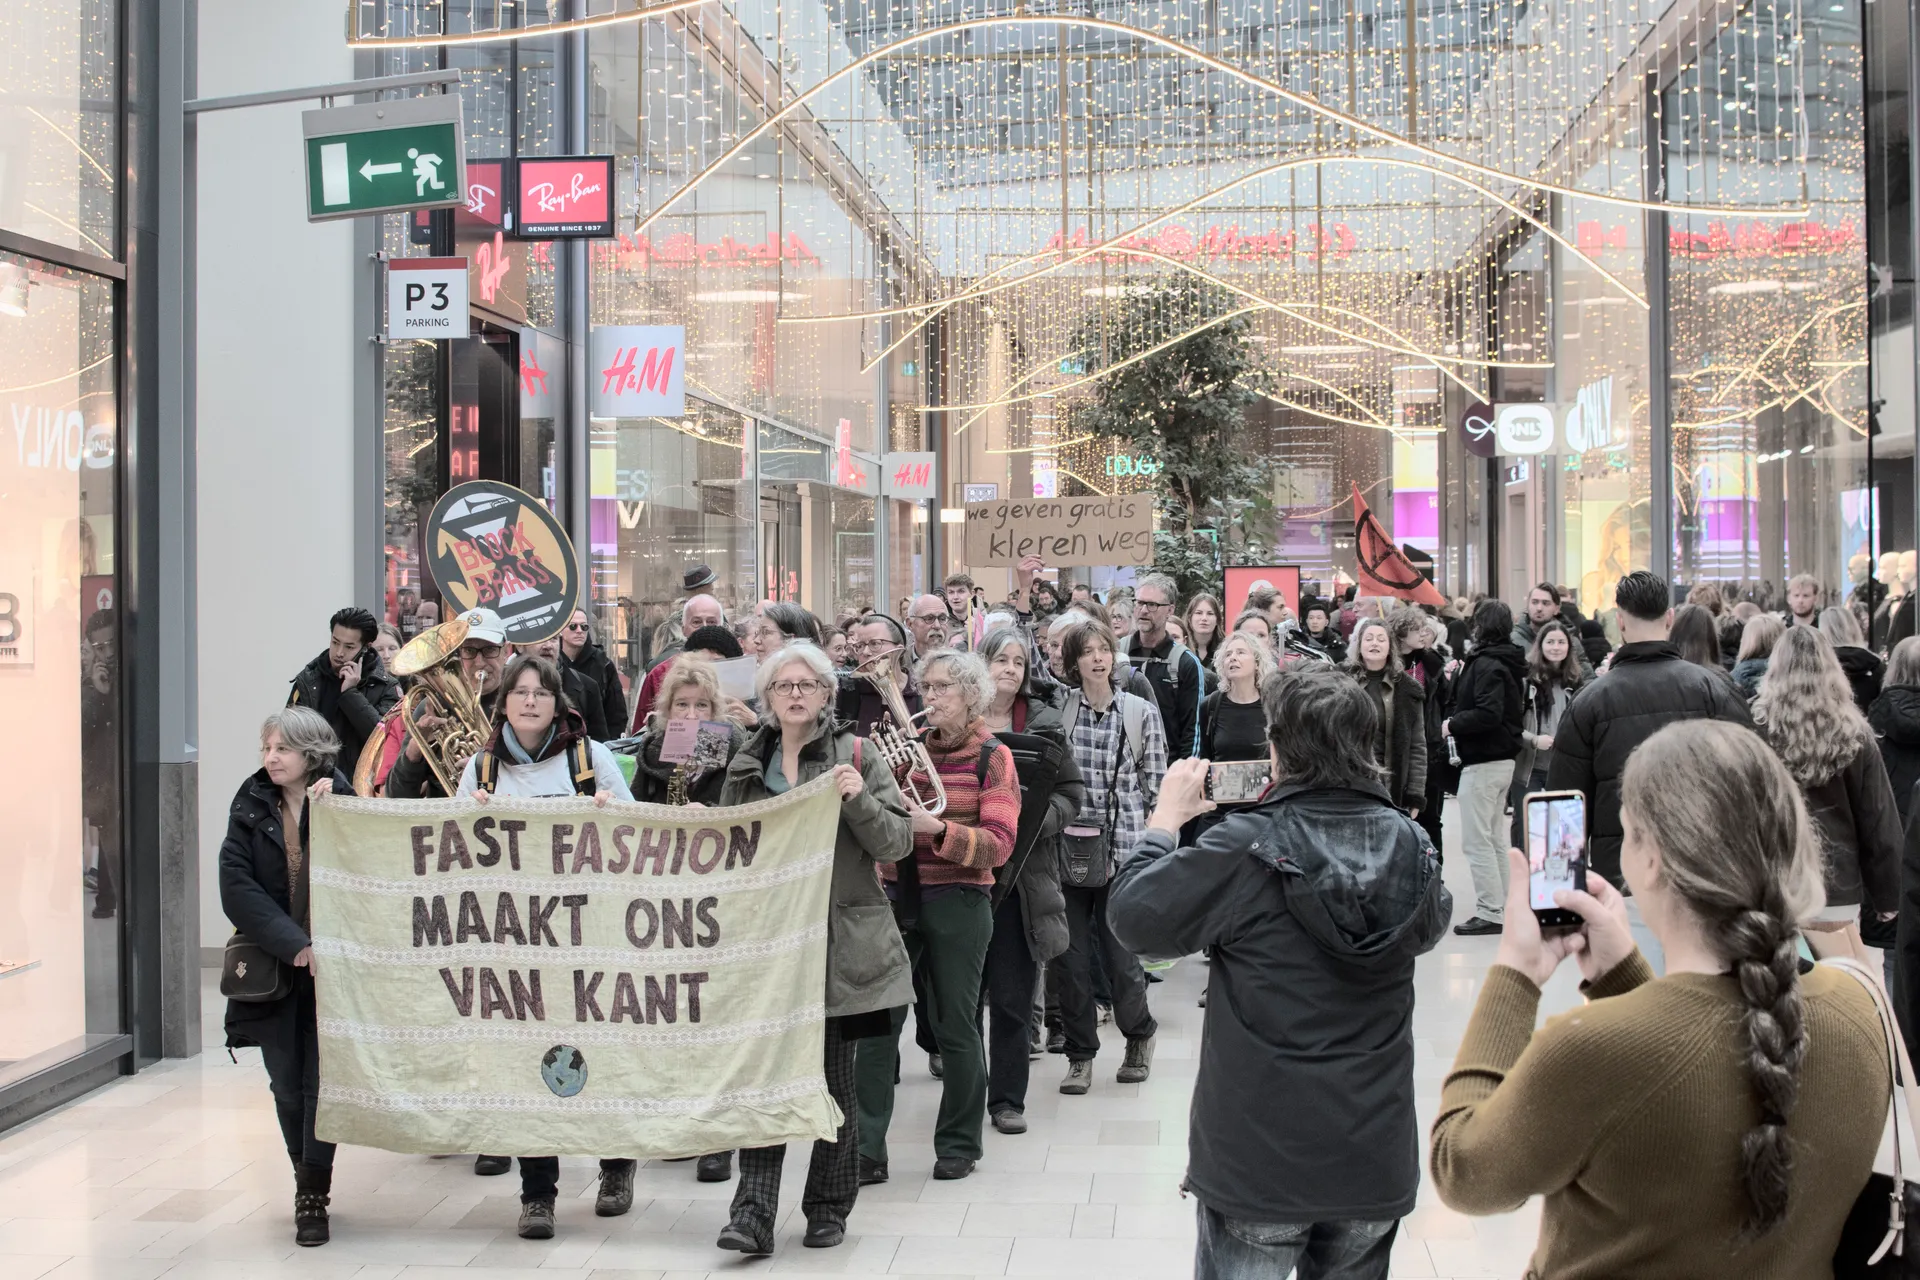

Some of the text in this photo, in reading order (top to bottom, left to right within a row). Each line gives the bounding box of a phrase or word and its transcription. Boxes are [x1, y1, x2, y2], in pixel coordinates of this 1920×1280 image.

[406, 318, 449, 327] PARKING
[602, 346, 675, 396] H&M
[1577, 376, 1613, 453] ONLY
[894, 462, 931, 488] H&M
[968, 499, 1135, 529] we geven gratis
[454, 521, 535, 571] BLOCK
[990, 529, 1149, 562] kleren weg
[469, 556, 551, 604] BRASS
[410, 816, 762, 876] FAST FASHION
[412, 891, 720, 948] MAAKT ONS
[439, 967, 709, 1024] VAN KANT
